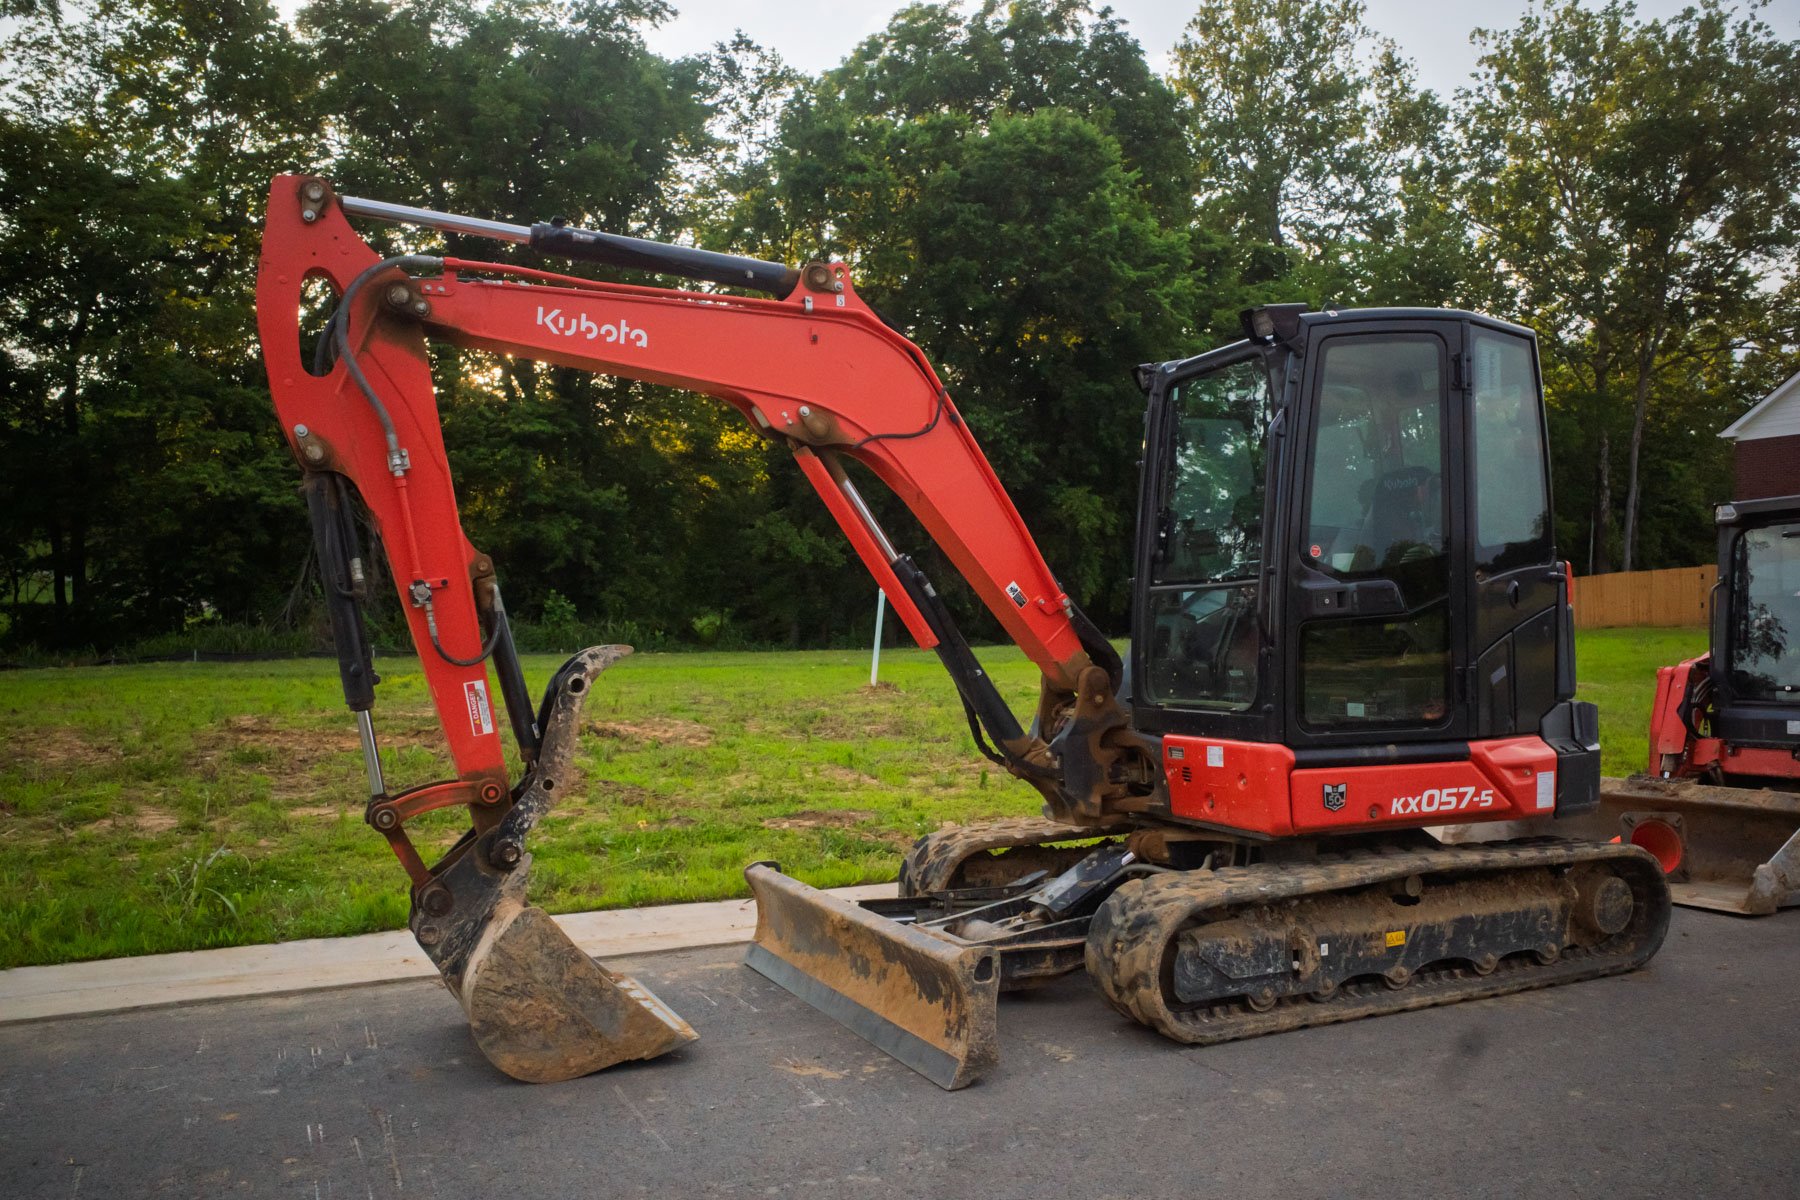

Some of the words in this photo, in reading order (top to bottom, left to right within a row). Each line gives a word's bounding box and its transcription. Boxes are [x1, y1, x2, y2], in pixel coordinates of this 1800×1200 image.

[537, 306, 648, 348] Kubota
[468, 690, 480, 720] DANGER
[1391, 786, 1494, 815] KX057-5
